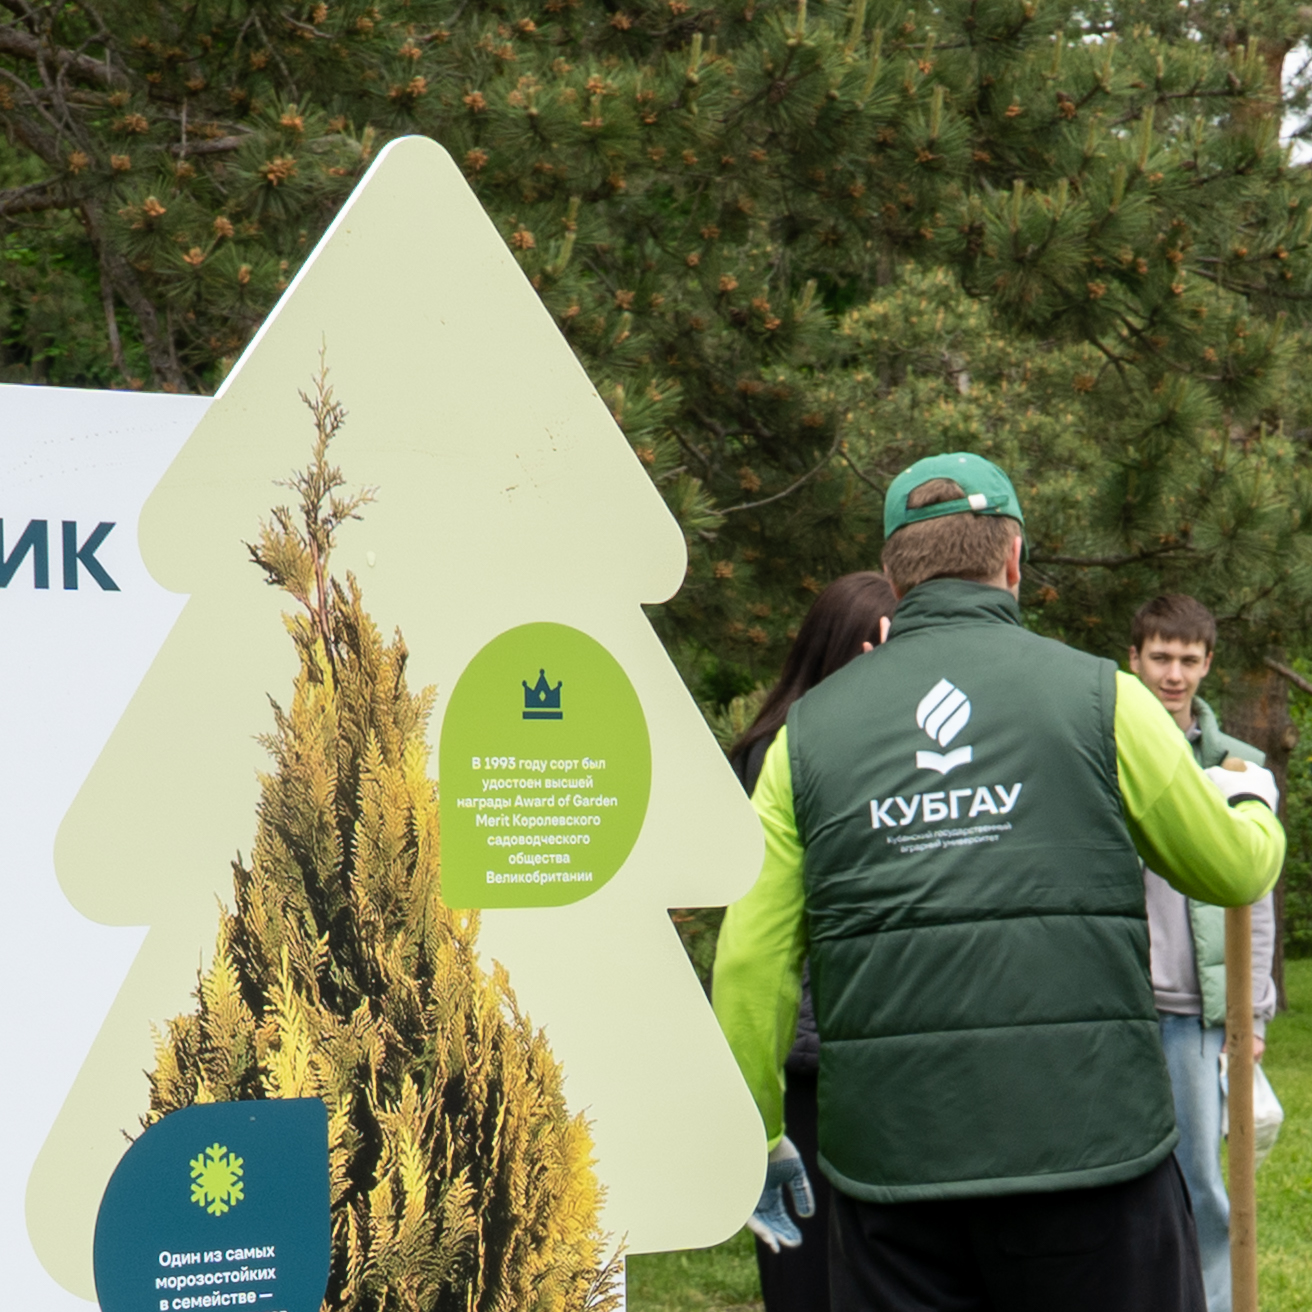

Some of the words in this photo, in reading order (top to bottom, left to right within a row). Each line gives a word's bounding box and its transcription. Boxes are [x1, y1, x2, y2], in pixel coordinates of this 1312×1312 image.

[471, 757, 482, 769] В
[484, 757, 516, 770] 1993
[519, 759, 546, 773] году
[549, 759, 579, 773] сорт
[581, 757, 606, 769] был
[482, 778, 542, 792] удостоен
[544, 775, 594, 788] высшей
[457, 797, 511, 810] награды
[514, 794, 555, 808] Award
[557, 794, 571, 807] of
[573, 794, 618, 807] Garden
[870, 783, 1022, 829] КУБГАУ
[476, 814, 510, 827] Merit
[512, 814, 601, 829] Королевского
[487, 834, 590, 847] садоводческого
[508, 852, 570, 866] общества
[486, 870, 593, 885] Великобритании
[159, 1251, 201, 1268] Один
[204, 1250, 223, 1263] из
[225, 1245, 275, 1261] самых
[155, 1266, 276, 1291] морозостойких
[159, 1298, 169, 1311] в
[172, 1290, 256, 1311] семействе
